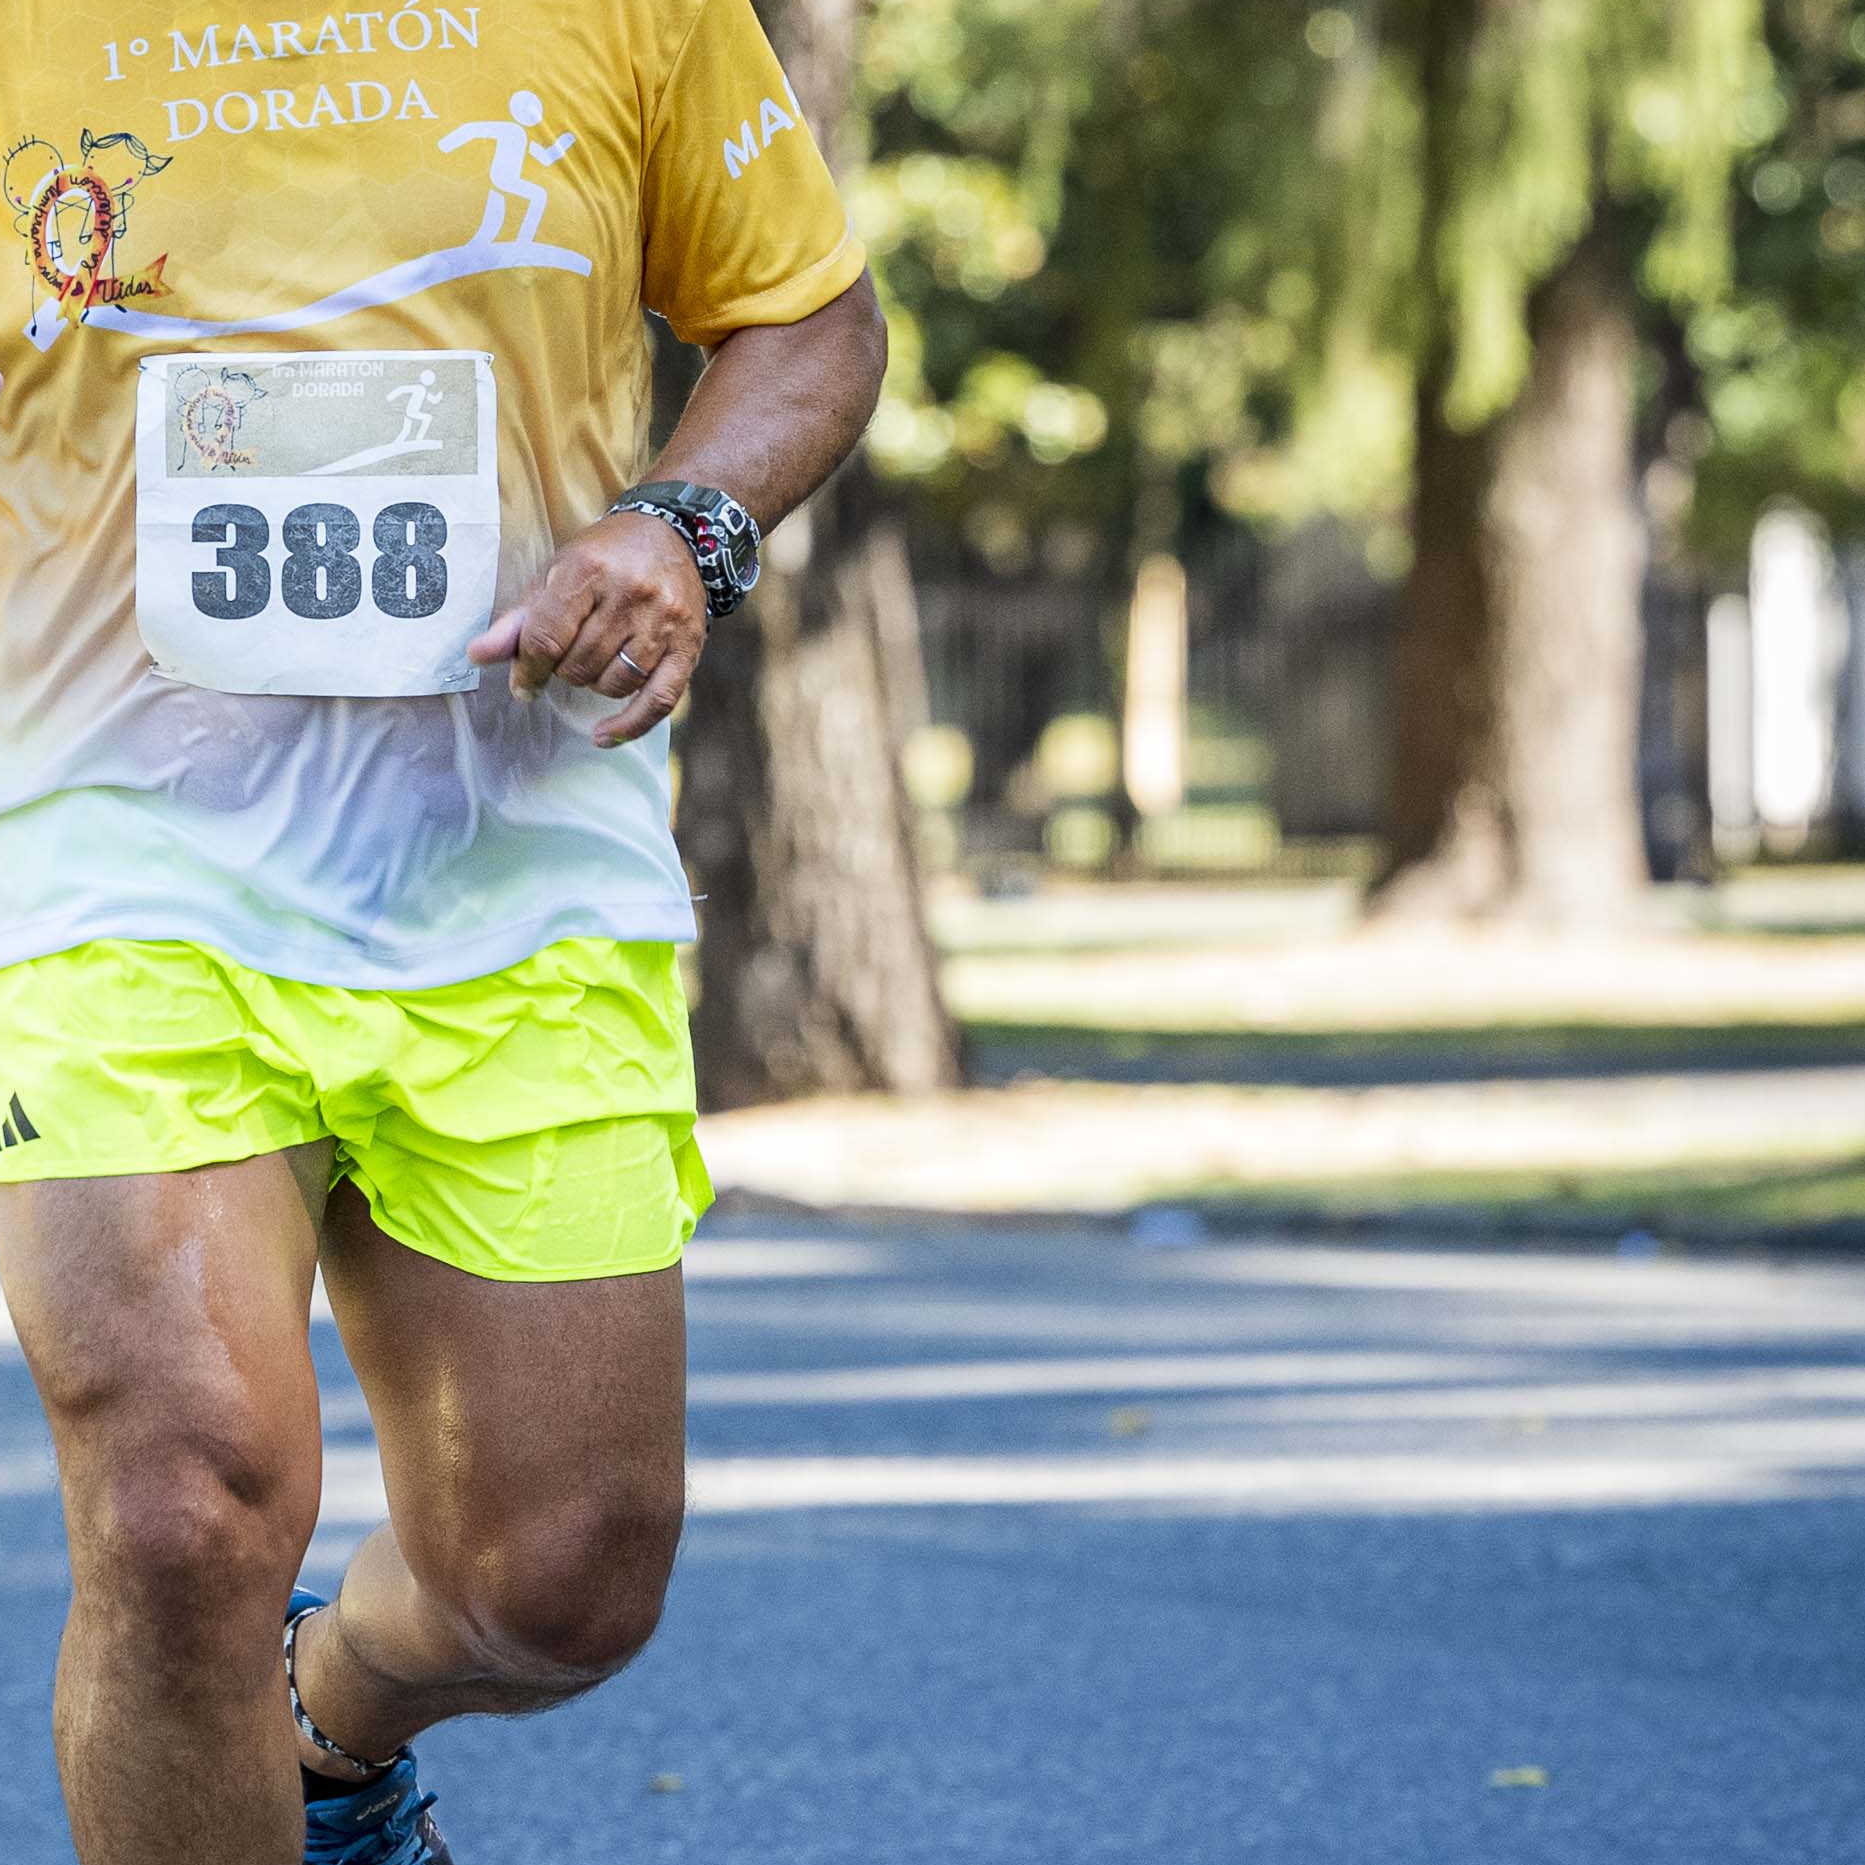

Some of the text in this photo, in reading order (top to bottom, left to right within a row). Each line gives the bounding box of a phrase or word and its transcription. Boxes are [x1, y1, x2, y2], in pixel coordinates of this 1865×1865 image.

[102, 38, 149, 81] 1°
[162, 79, 438, 142] DORADA
[723, 74, 801, 180] MA
[96, 274, 154, 303] Vidas
[292, 381, 365, 398] DORADA
[191, 502, 447, 620] 388
